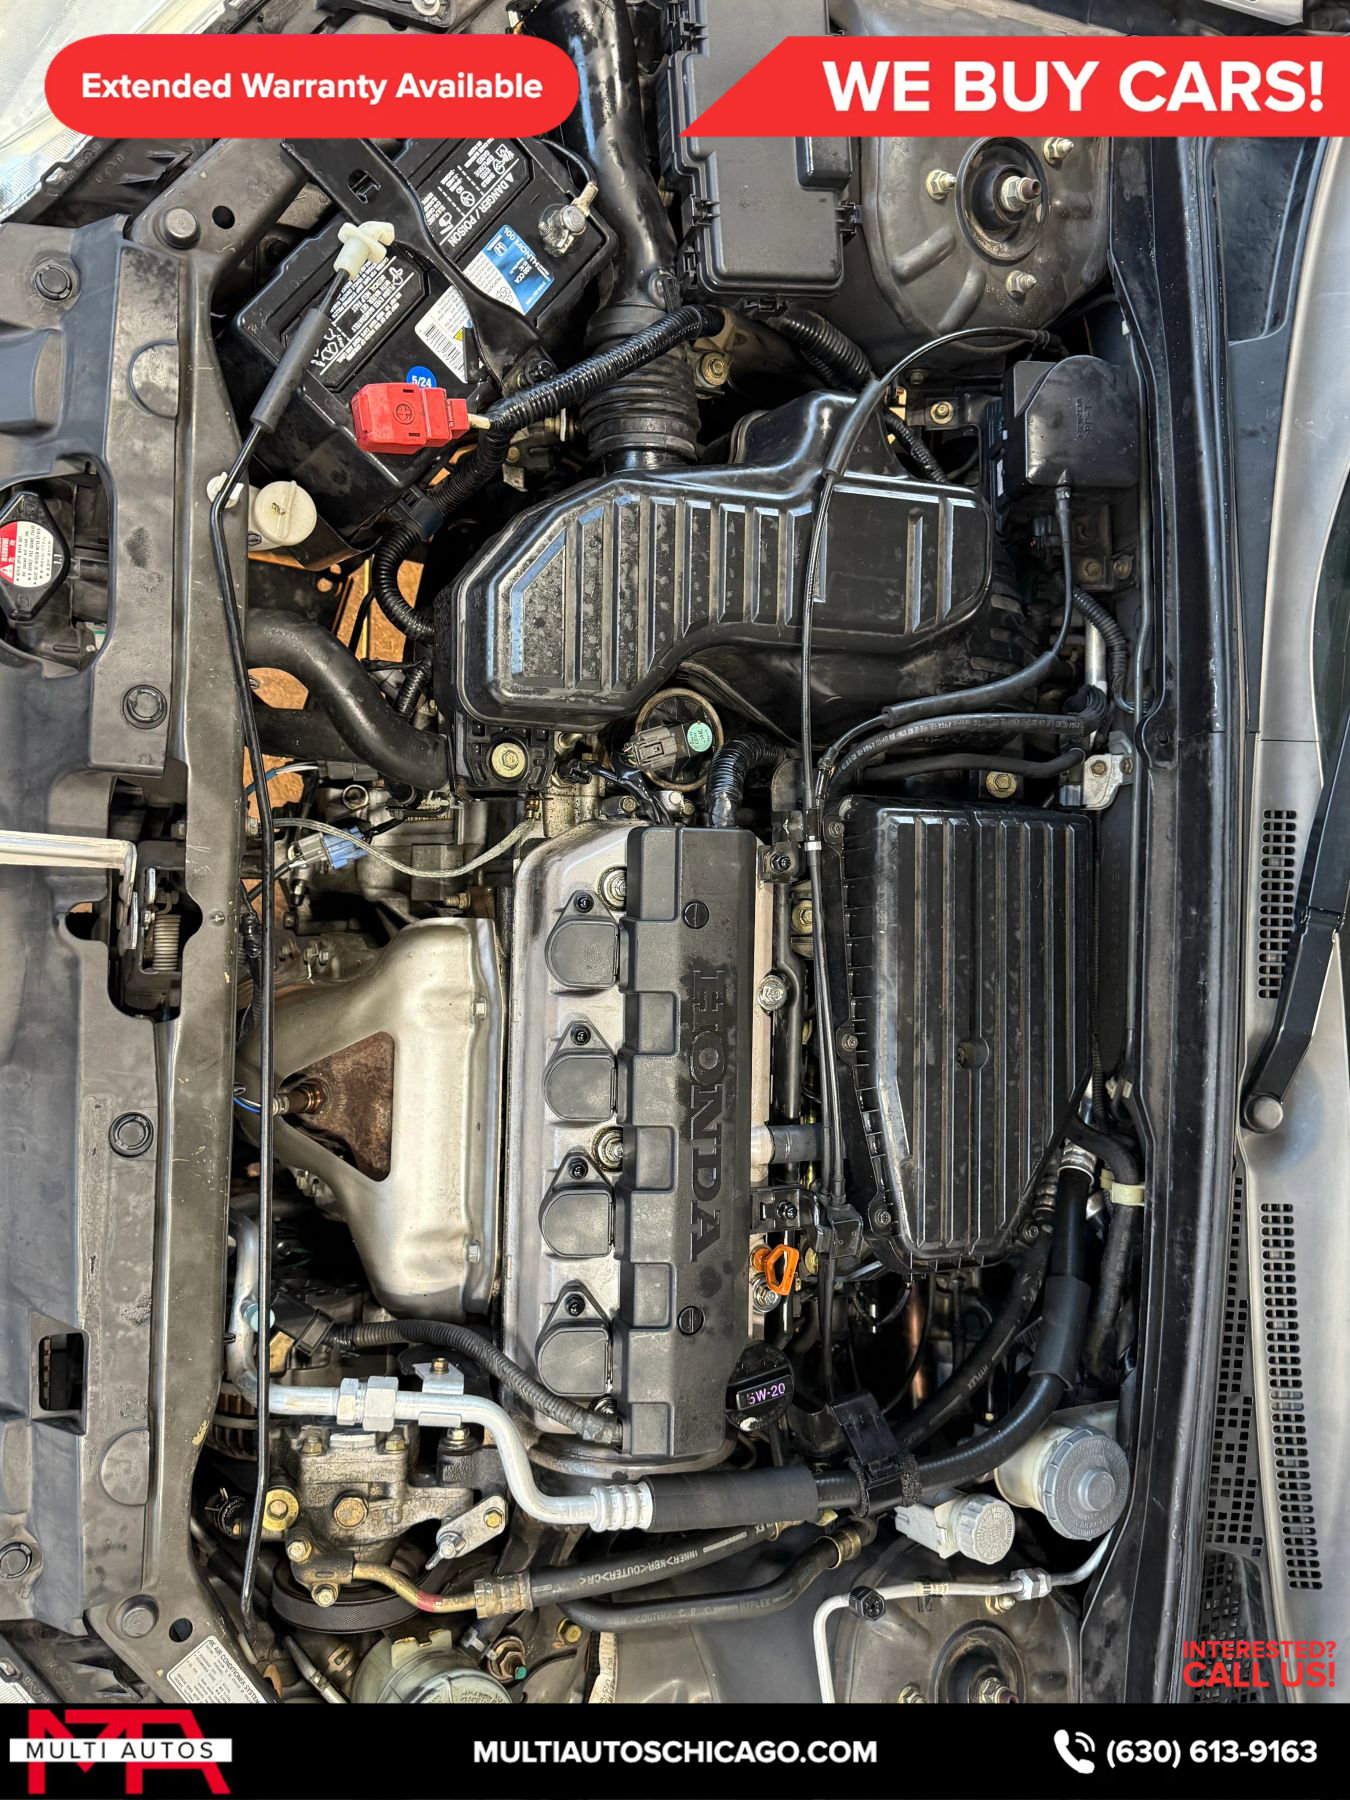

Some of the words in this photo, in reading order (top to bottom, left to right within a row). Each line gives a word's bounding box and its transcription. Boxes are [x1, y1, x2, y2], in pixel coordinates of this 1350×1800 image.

[477, 179, 510, 213] DANGER
[446, 214, 477, 247] POISON
[502, 226, 516, 241] 100
[513, 238, 539, 268] MONTH
[410, 375, 432, 388] 5/24
[688, 969, 725, 1263] HONDA
[746, 1381, 786, 1405] 5W-20
[212, 1645, 223, 1655] AIR
[219, 1653, 247, 1686] CONDITIONER
